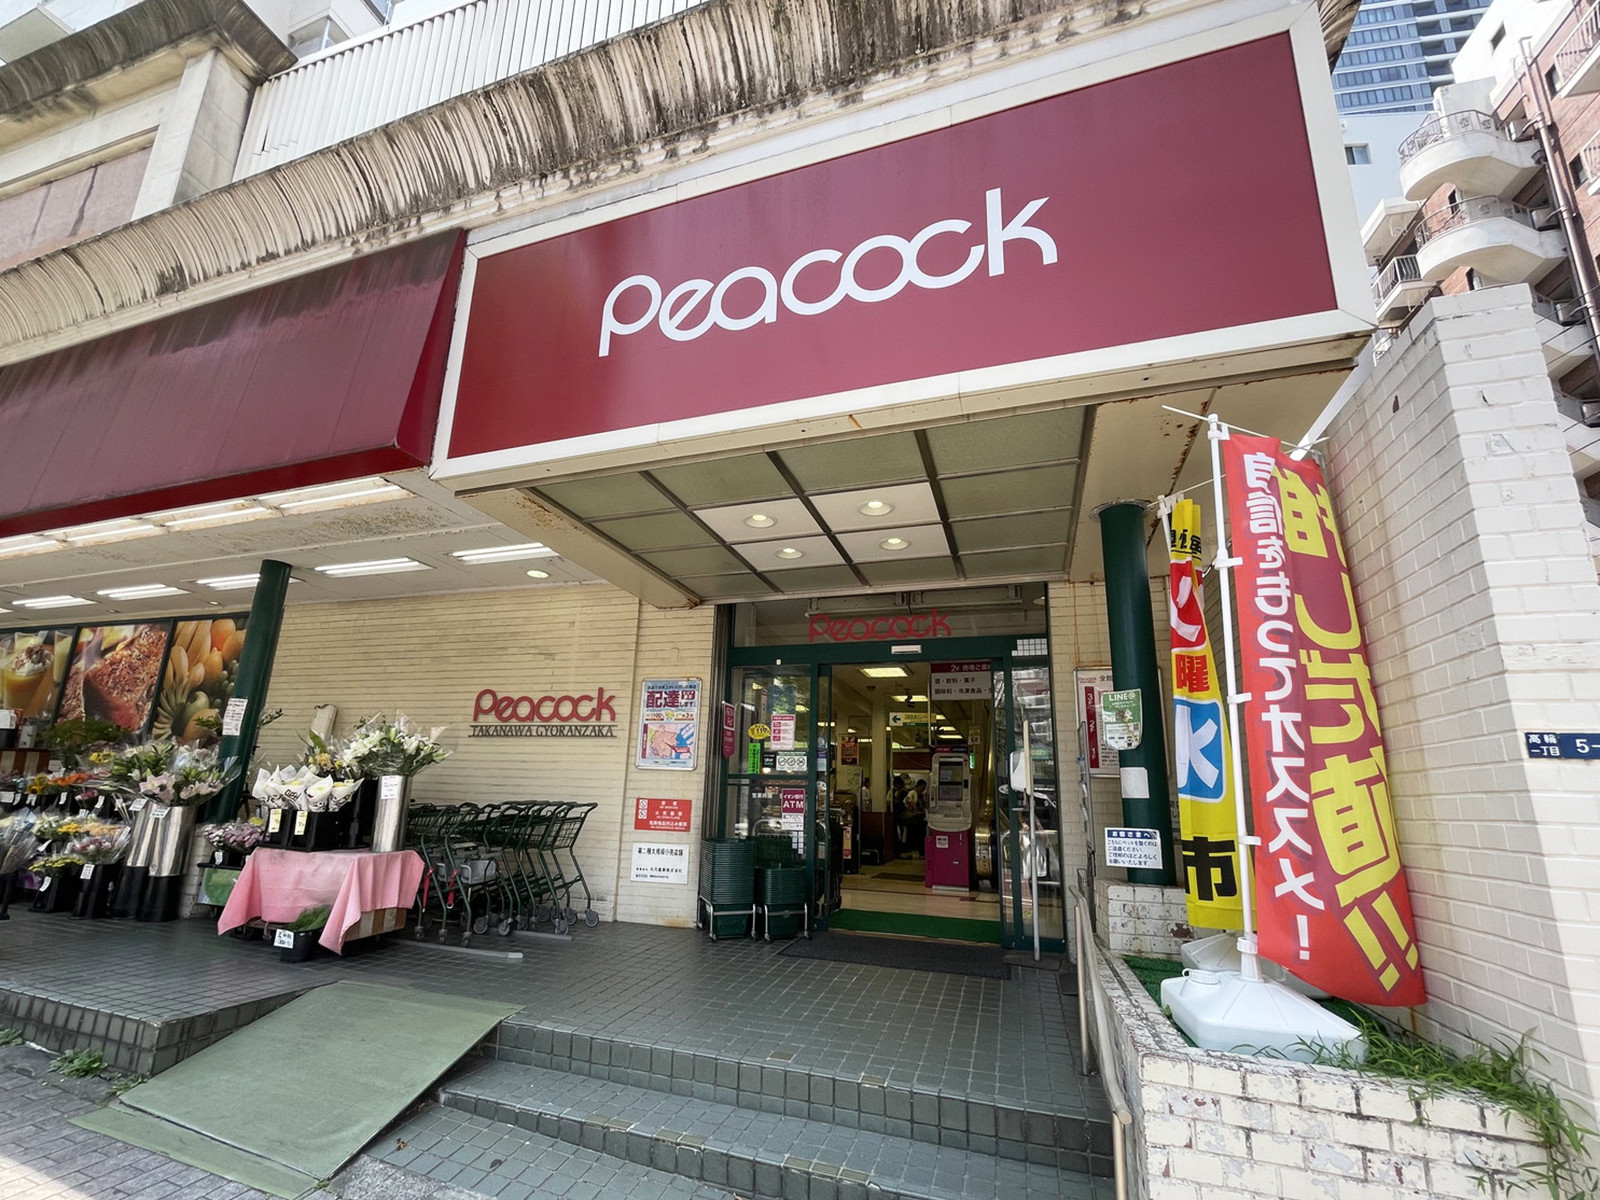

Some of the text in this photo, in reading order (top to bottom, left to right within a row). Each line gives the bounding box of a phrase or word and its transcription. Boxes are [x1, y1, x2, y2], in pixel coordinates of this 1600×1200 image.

[645, 690, 680, 709] 配達
[472, 725, 614, 737] TAKANAWA GYORANZAKA
[1528, 733, 1557, 744] 高輪
[1530, 745, 1560, 756] 一丁目
[783, 800, 804, 809] ATM
